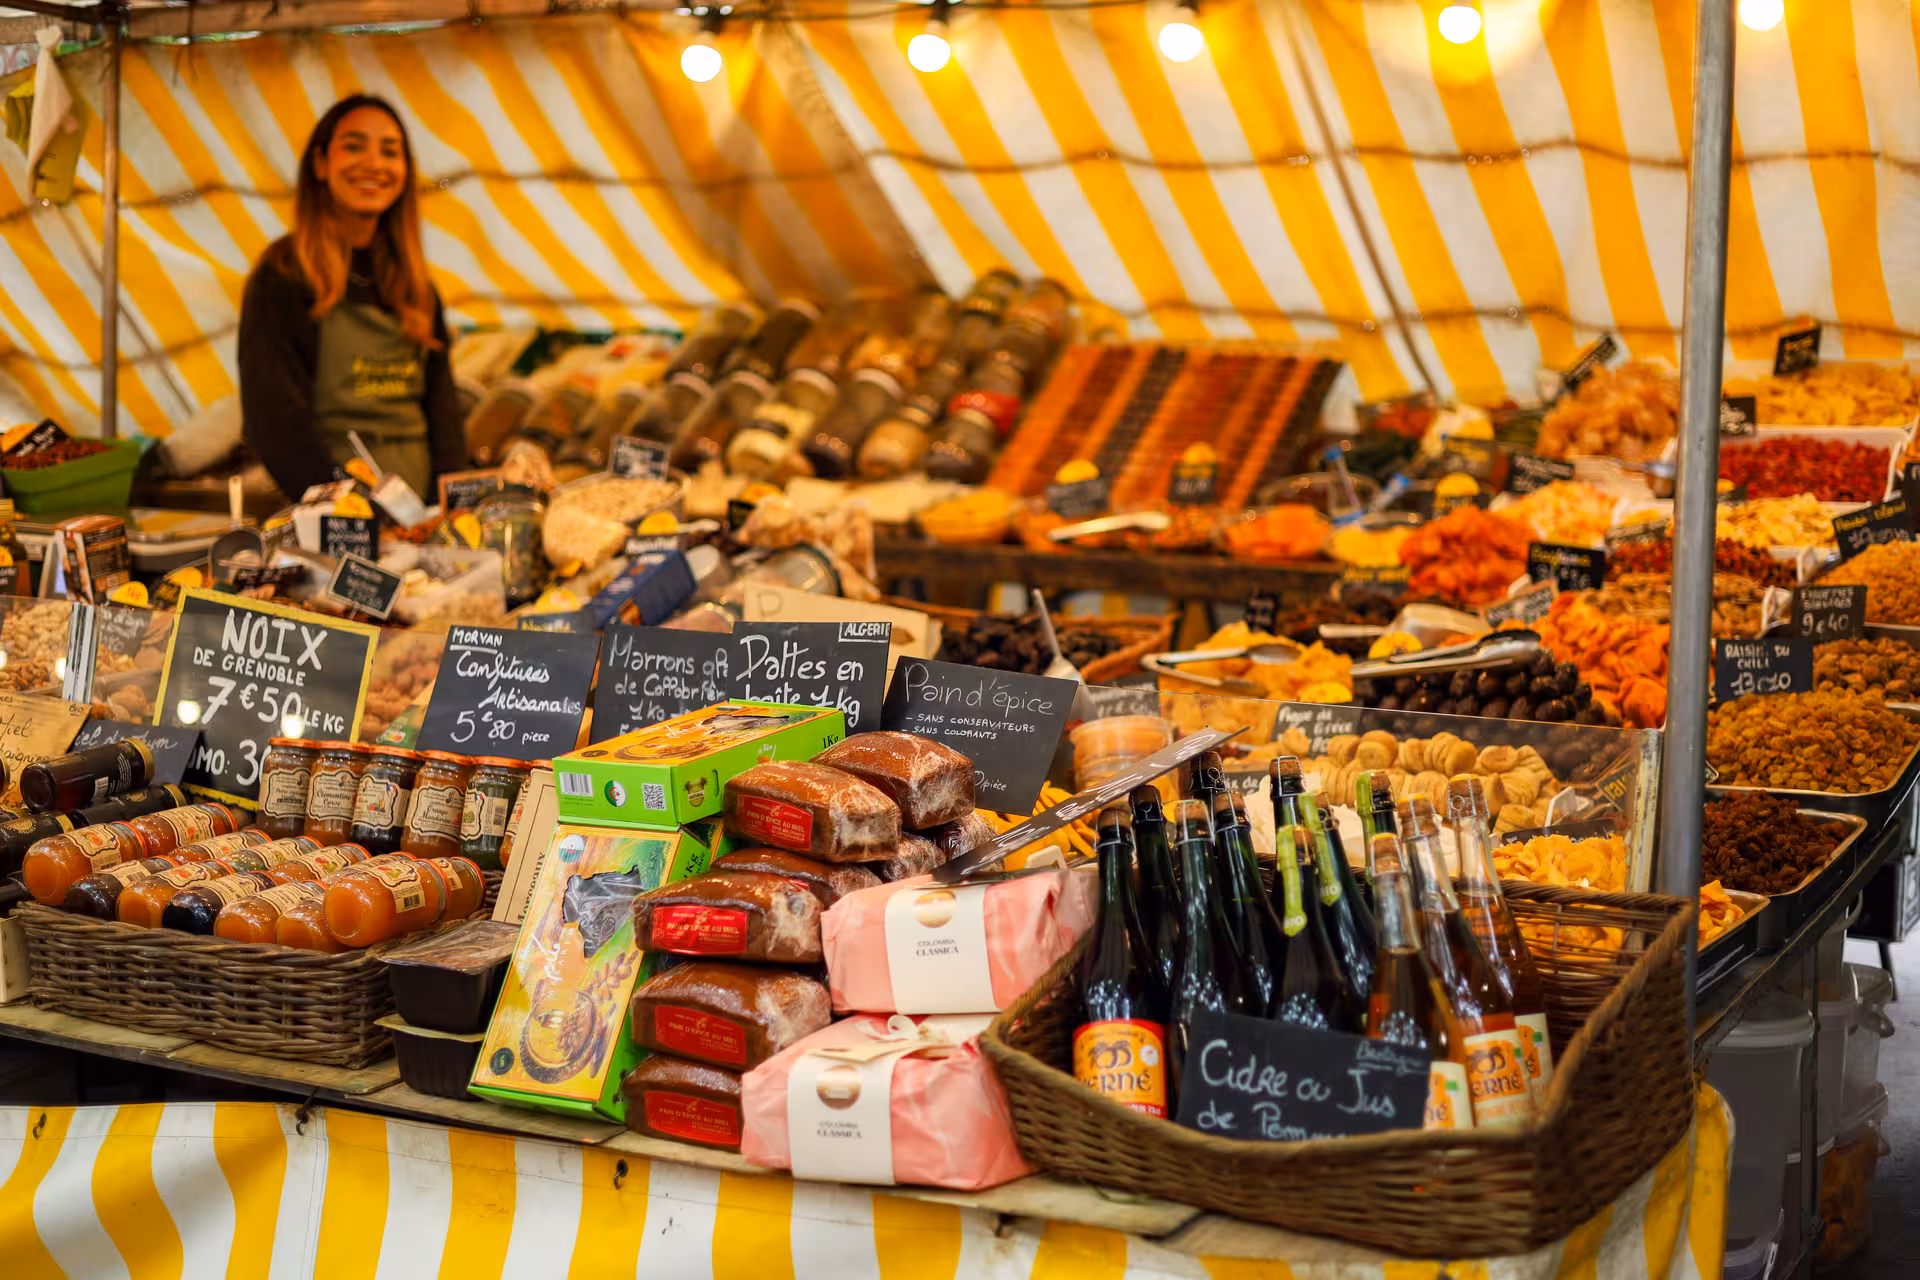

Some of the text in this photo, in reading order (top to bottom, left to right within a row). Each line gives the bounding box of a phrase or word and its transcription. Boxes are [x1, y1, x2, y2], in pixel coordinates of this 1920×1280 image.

[222, 608, 328, 670] NOIX
[452, 629, 503, 646] MORVAN
[193, 647, 306, 687] DE GRENOBLE
[608, 633, 695, 675] Marrons
[736, 634, 864, 682] Dattes en
[615, 673, 638, 695] de
[904, 662, 962, 706] Pain
[304, 706, 322, 728] LE
[323, 712, 345, 734] KG
[912, 725, 998, 740] SANS COLORANTS
[917, 714, 1036, 733] SANS CONSERVATEURS
[74, 726, 102, 747] iel
[916, 945, 959, 957] CLASSICA
[918, 938, 956, 946] COLOMBA
[1337, 1068, 1397, 1119] Jus
[1198, 1099, 1238, 1129] de
